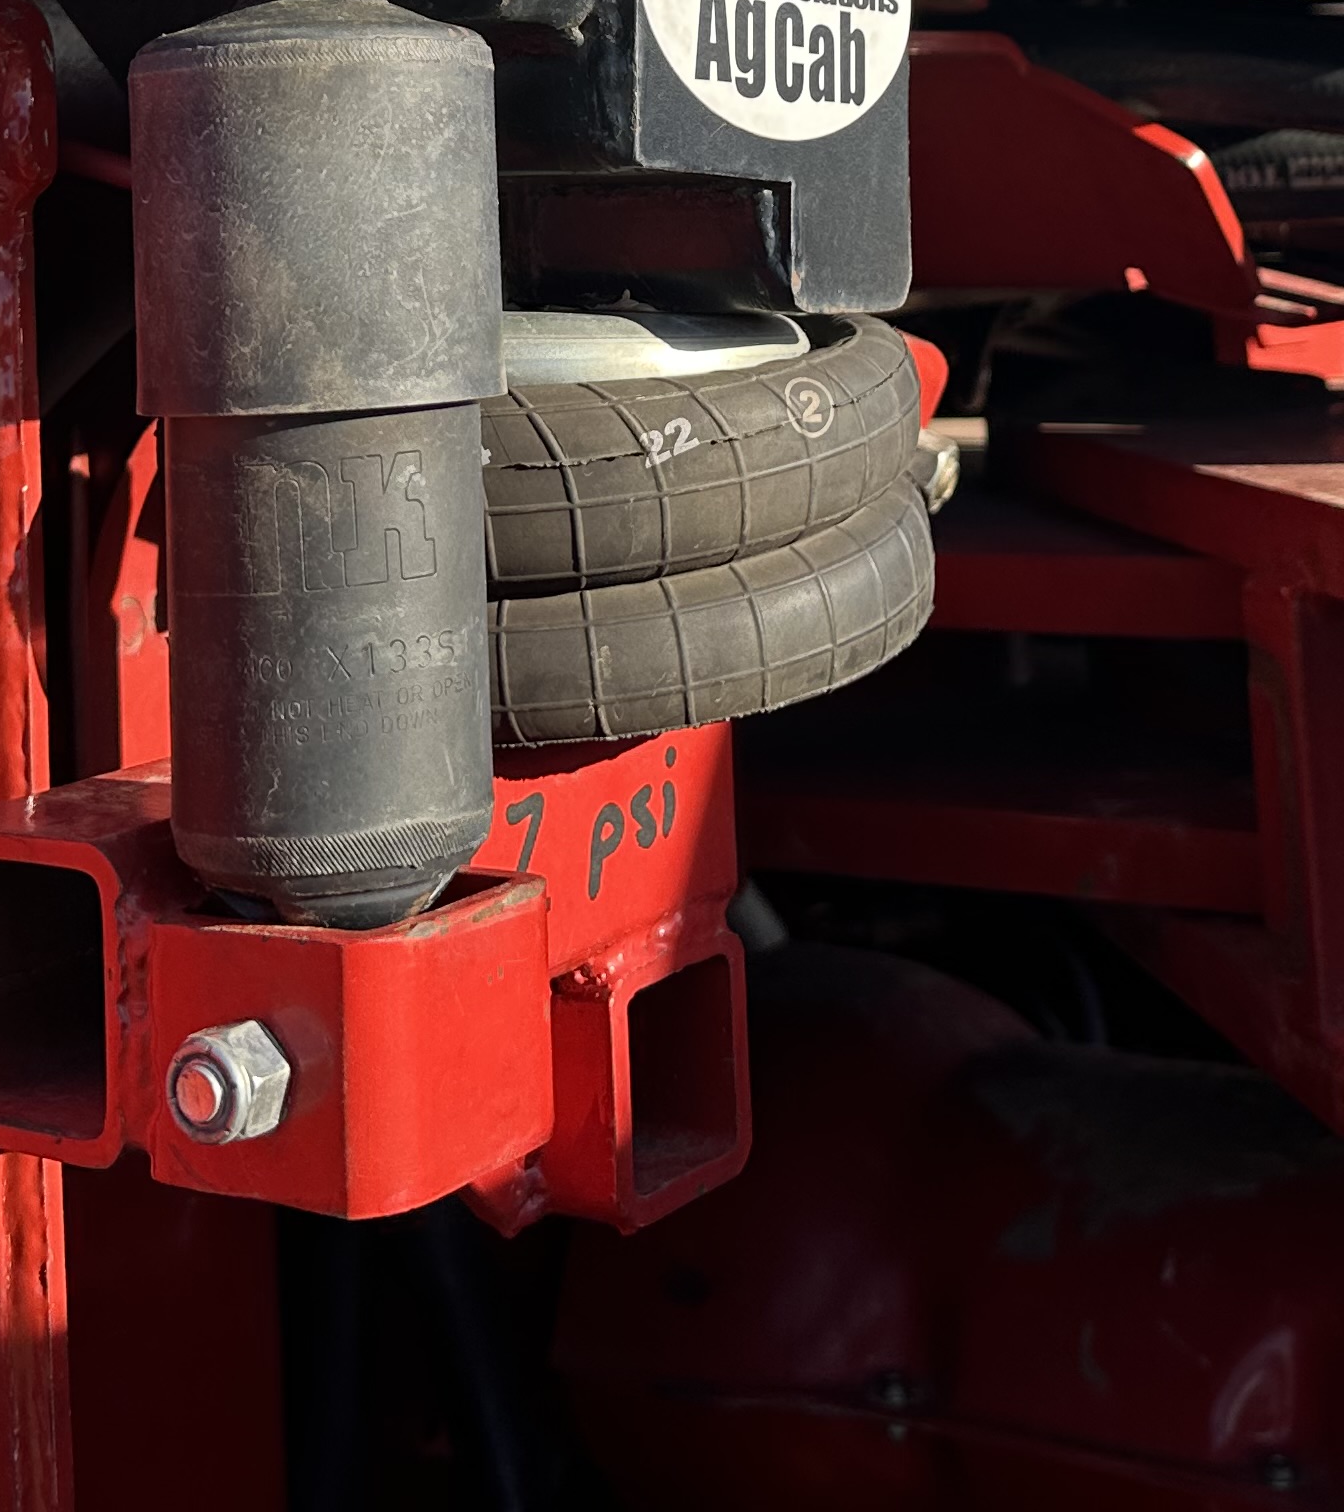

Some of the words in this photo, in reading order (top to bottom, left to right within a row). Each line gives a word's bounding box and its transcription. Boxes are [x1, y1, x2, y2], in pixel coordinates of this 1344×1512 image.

[640, 417, 701, 469] 22
[270, 699, 313, 722] NOT
[327, 690, 383, 718] HEAT
[397, 684, 423, 706] OR
[588, 746, 677, 900] psi
